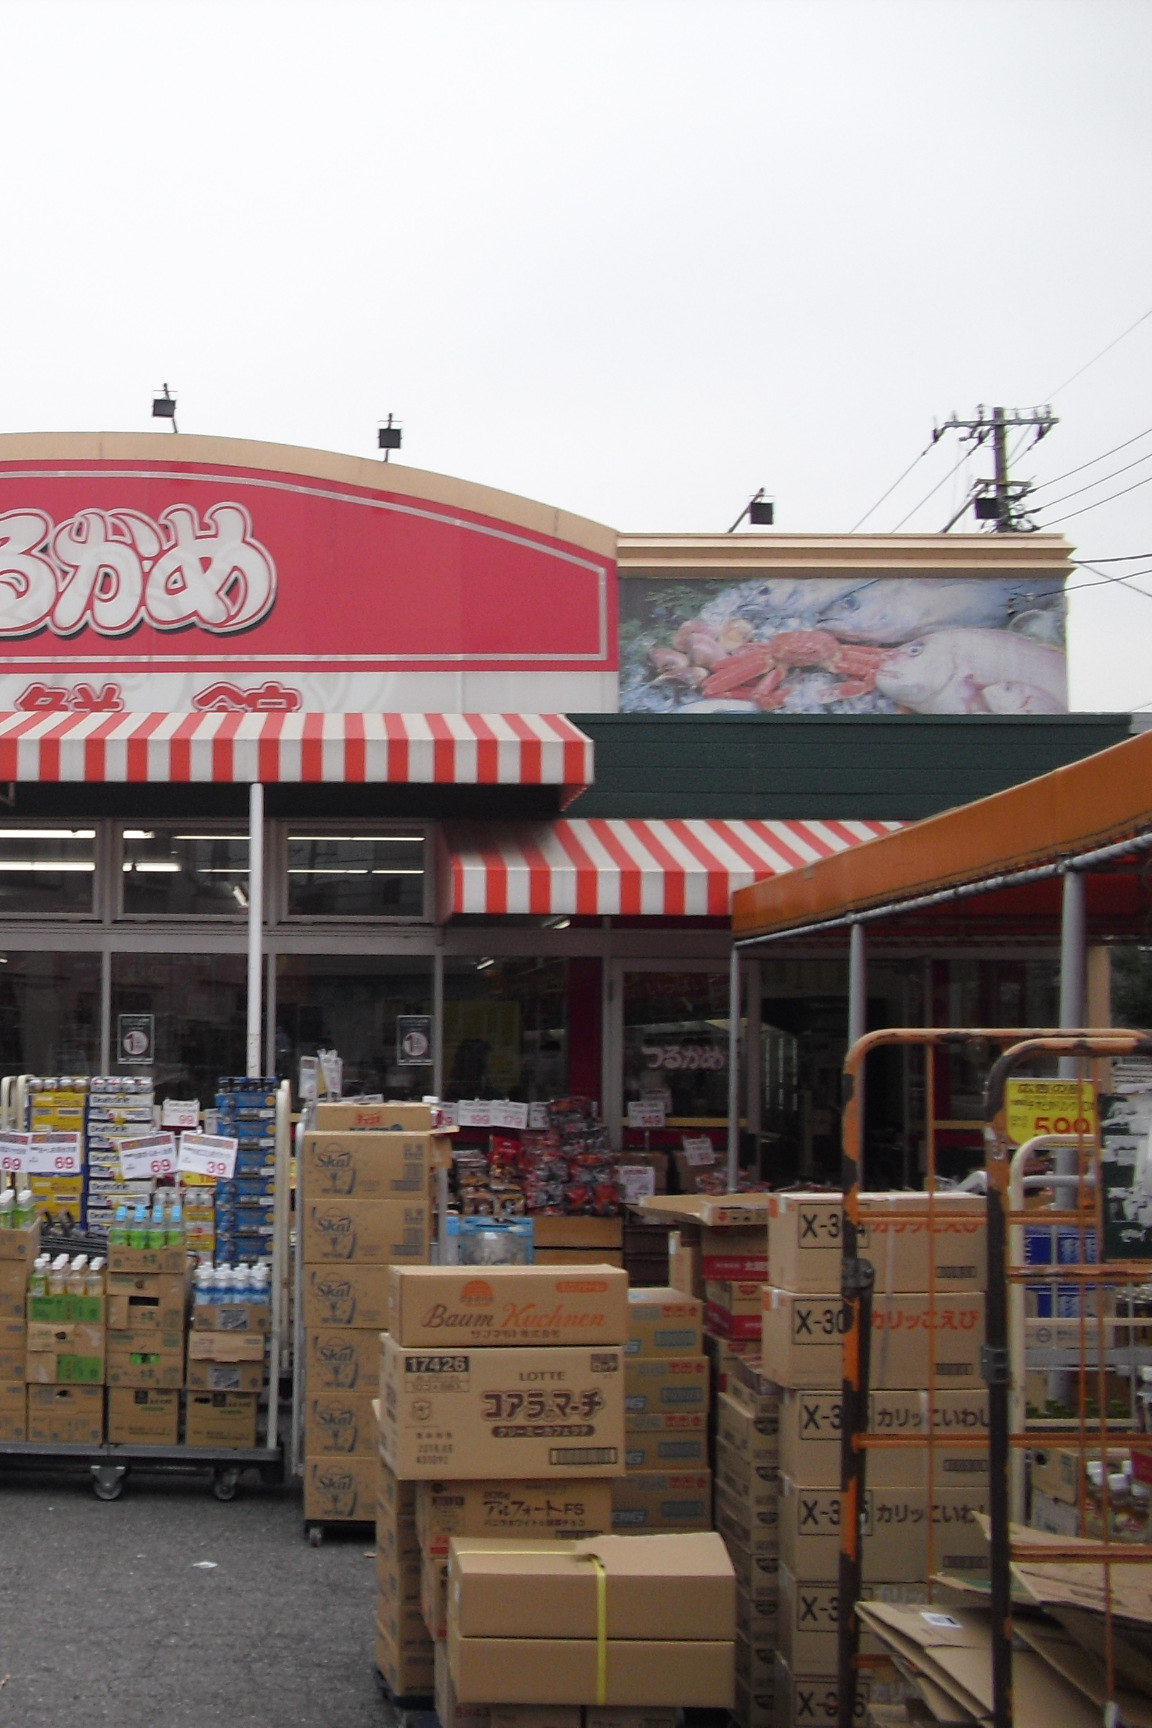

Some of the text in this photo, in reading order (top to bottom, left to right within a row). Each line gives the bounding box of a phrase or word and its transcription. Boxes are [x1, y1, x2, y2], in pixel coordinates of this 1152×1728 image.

[642, 1046, 725, 1070] つるかめ
[2, 1157, 21, 1170] 69
[55, 1157, 74, 1169] 69
[151, 1159, 171, 1173] 69
[207, 1161, 227, 1174] 39
[422, 1304, 494, 1328] Baum
[408, 1357, 465, 1372] 17426
[519, 1372, 566, 1381] LOTTE
